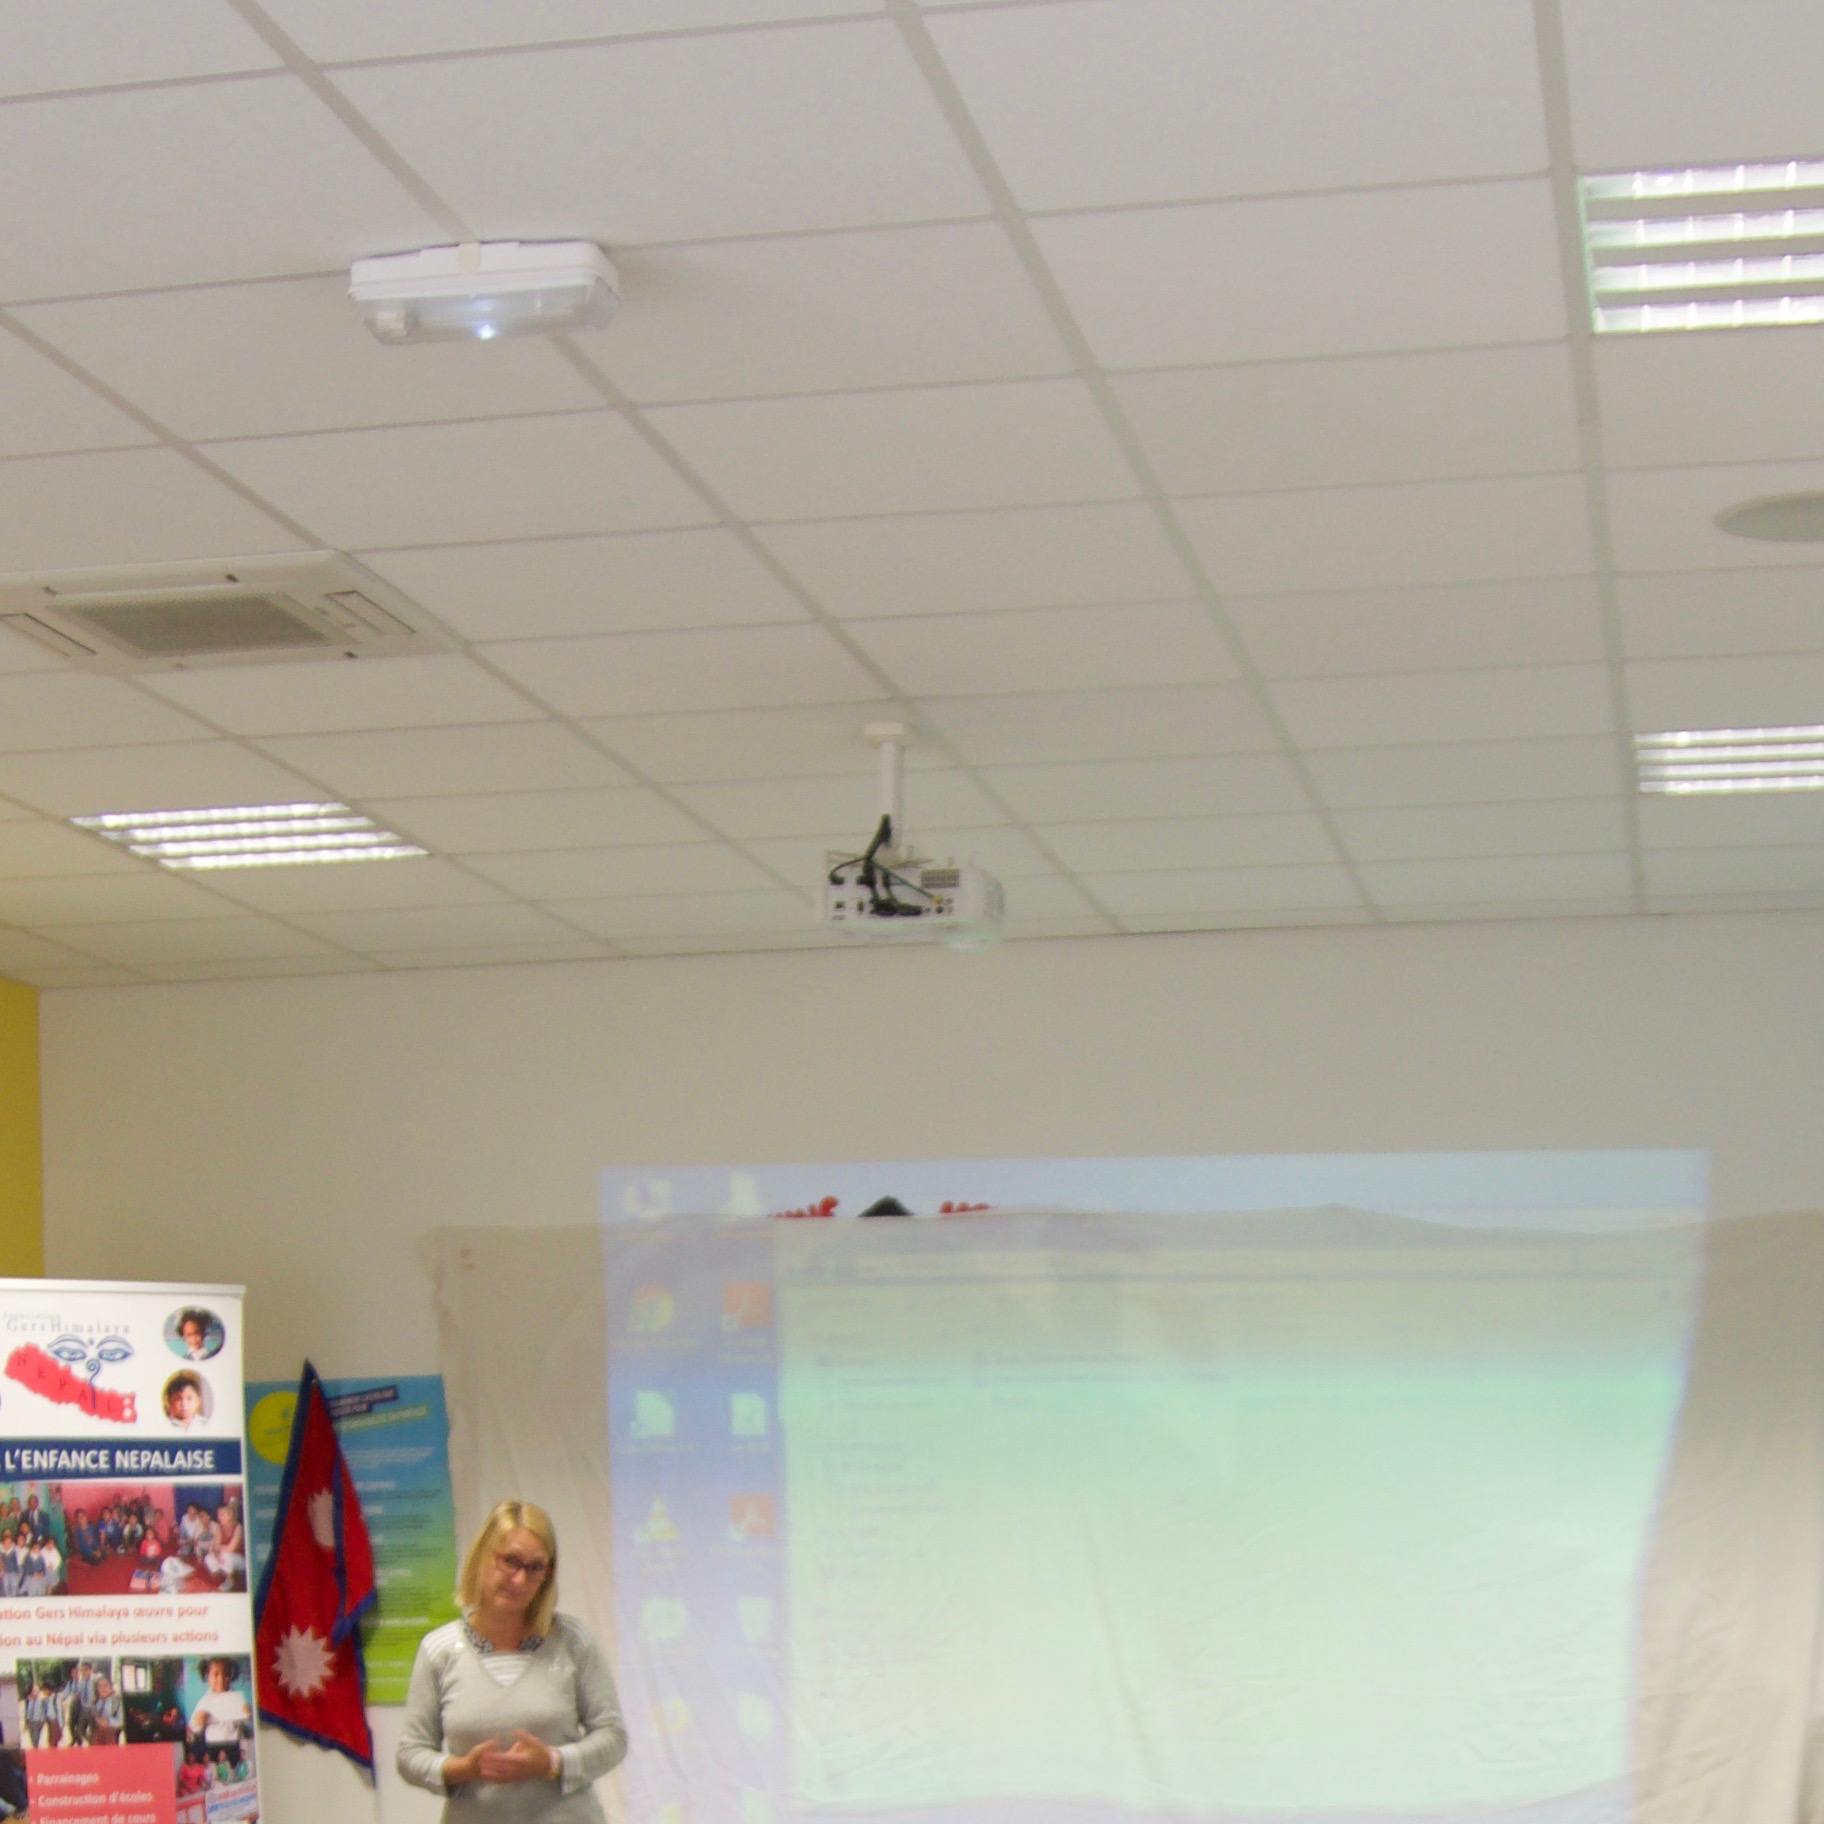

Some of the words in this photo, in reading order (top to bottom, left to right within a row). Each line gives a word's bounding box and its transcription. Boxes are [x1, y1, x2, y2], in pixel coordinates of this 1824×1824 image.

[5, 1447, 111, 1471] L'ENFANCE
[114, 1448, 215, 1470] NEPALAISE
[35, 1606, 65, 1620] Gers
[68, 1605, 129, 1621] Himalaya
[177, 1605, 209, 1618] pour
[26, 1635, 42, 1646] au
[46, 1631, 84, 1646] Népal
[87, 1631, 107, 1644] via
[111, 1630, 167, 1645] plusieurs
[172, 1629, 219, 1643] actions
[37, 1793, 106, 1808] Construction
